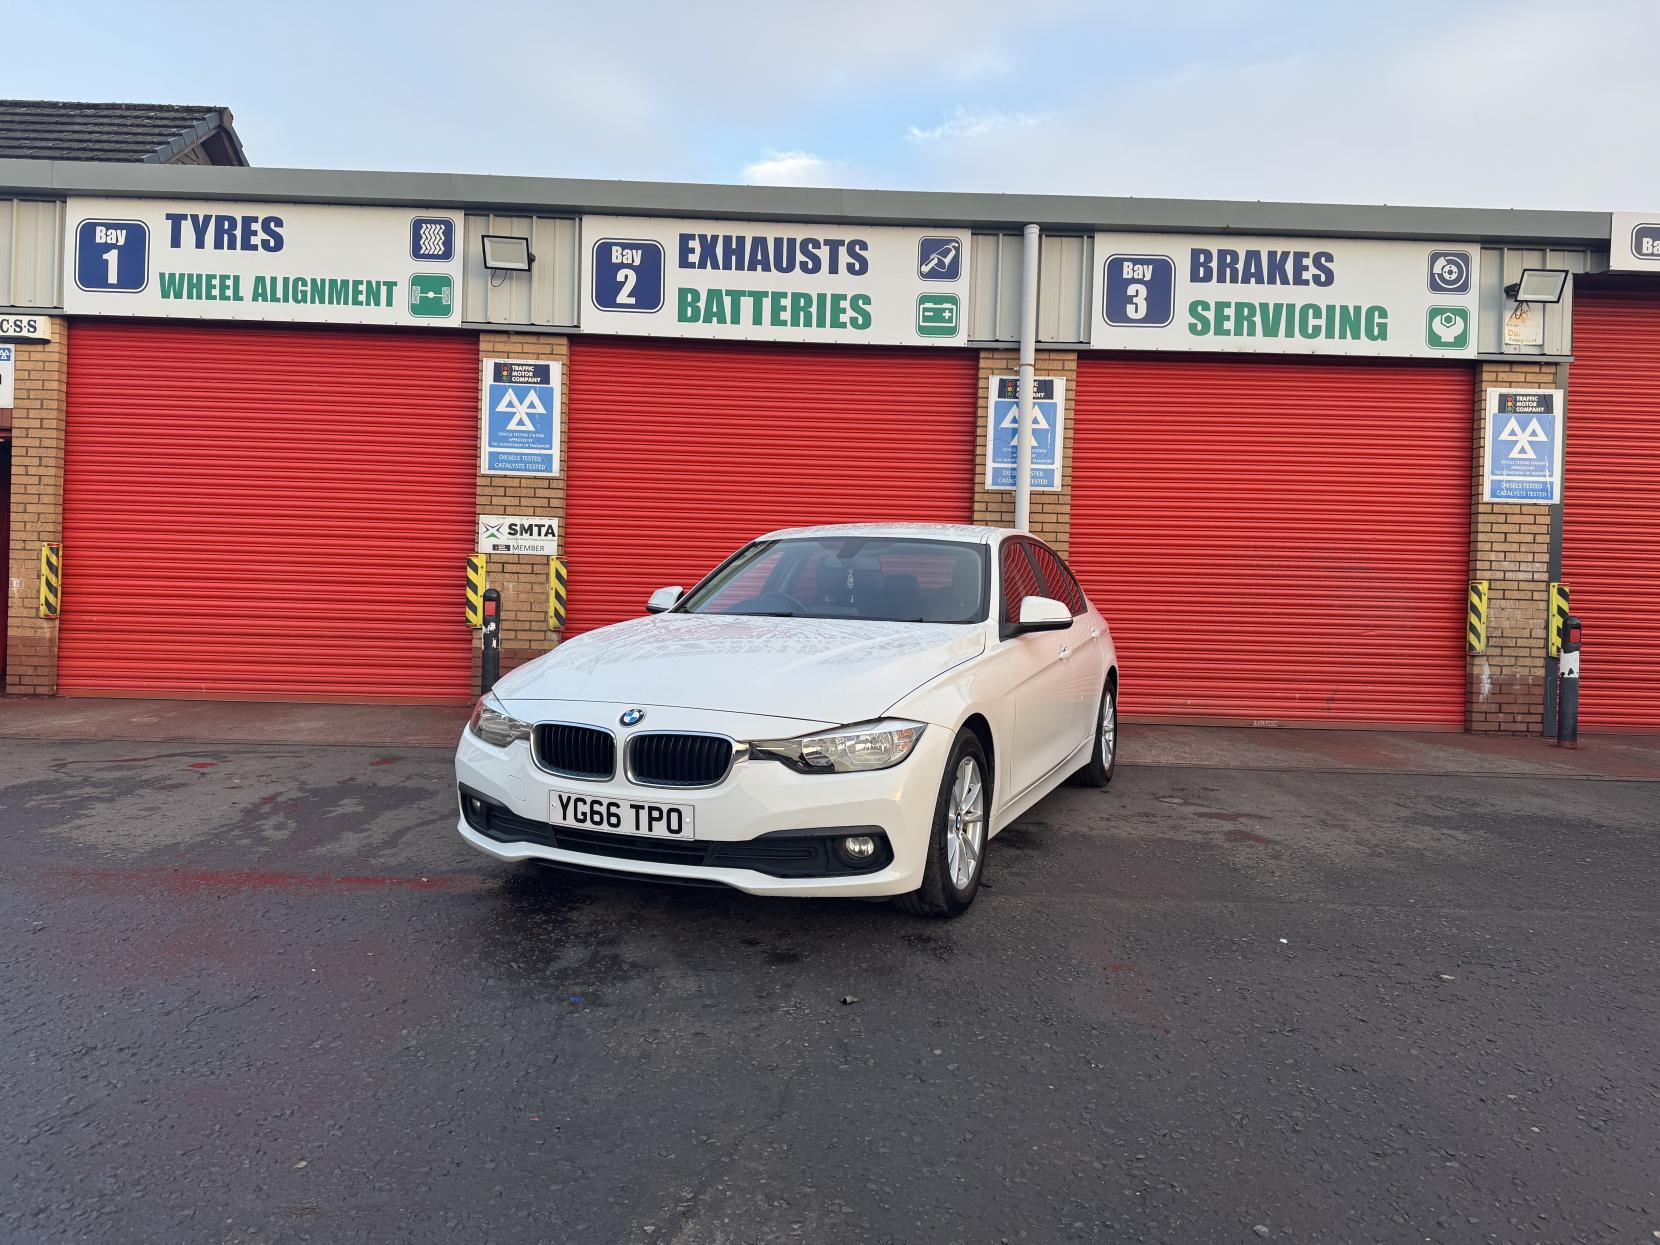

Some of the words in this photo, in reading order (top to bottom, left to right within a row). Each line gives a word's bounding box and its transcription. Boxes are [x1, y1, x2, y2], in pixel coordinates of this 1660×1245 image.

[96, 226, 126, 246] Bay
[166, 212, 284, 252] TYRES
[1642, 237, 1660, 254] Ba
[102, 249, 118, 284] 1
[611, 245, 642, 266] Bay
[678, 233, 869, 276] EXHAUSTS
[1122, 262, 1152, 281] Bay
[1190, 248, 1334, 288] BRAKES
[158, 272, 244, 302] WHEEL
[252, 276, 398, 308] ALIGNMENT
[616, 268, 637, 304] 2
[1126, 284, 1148, 320] 3
[677, 287, 872, 330] BATTERIES
[1188, 300, 1388, 342] SERVICING
[508, 523, 556, 537] SMTA
[558, 794, 622, 828] YG66
[630, 804, 683, 834] TPO
